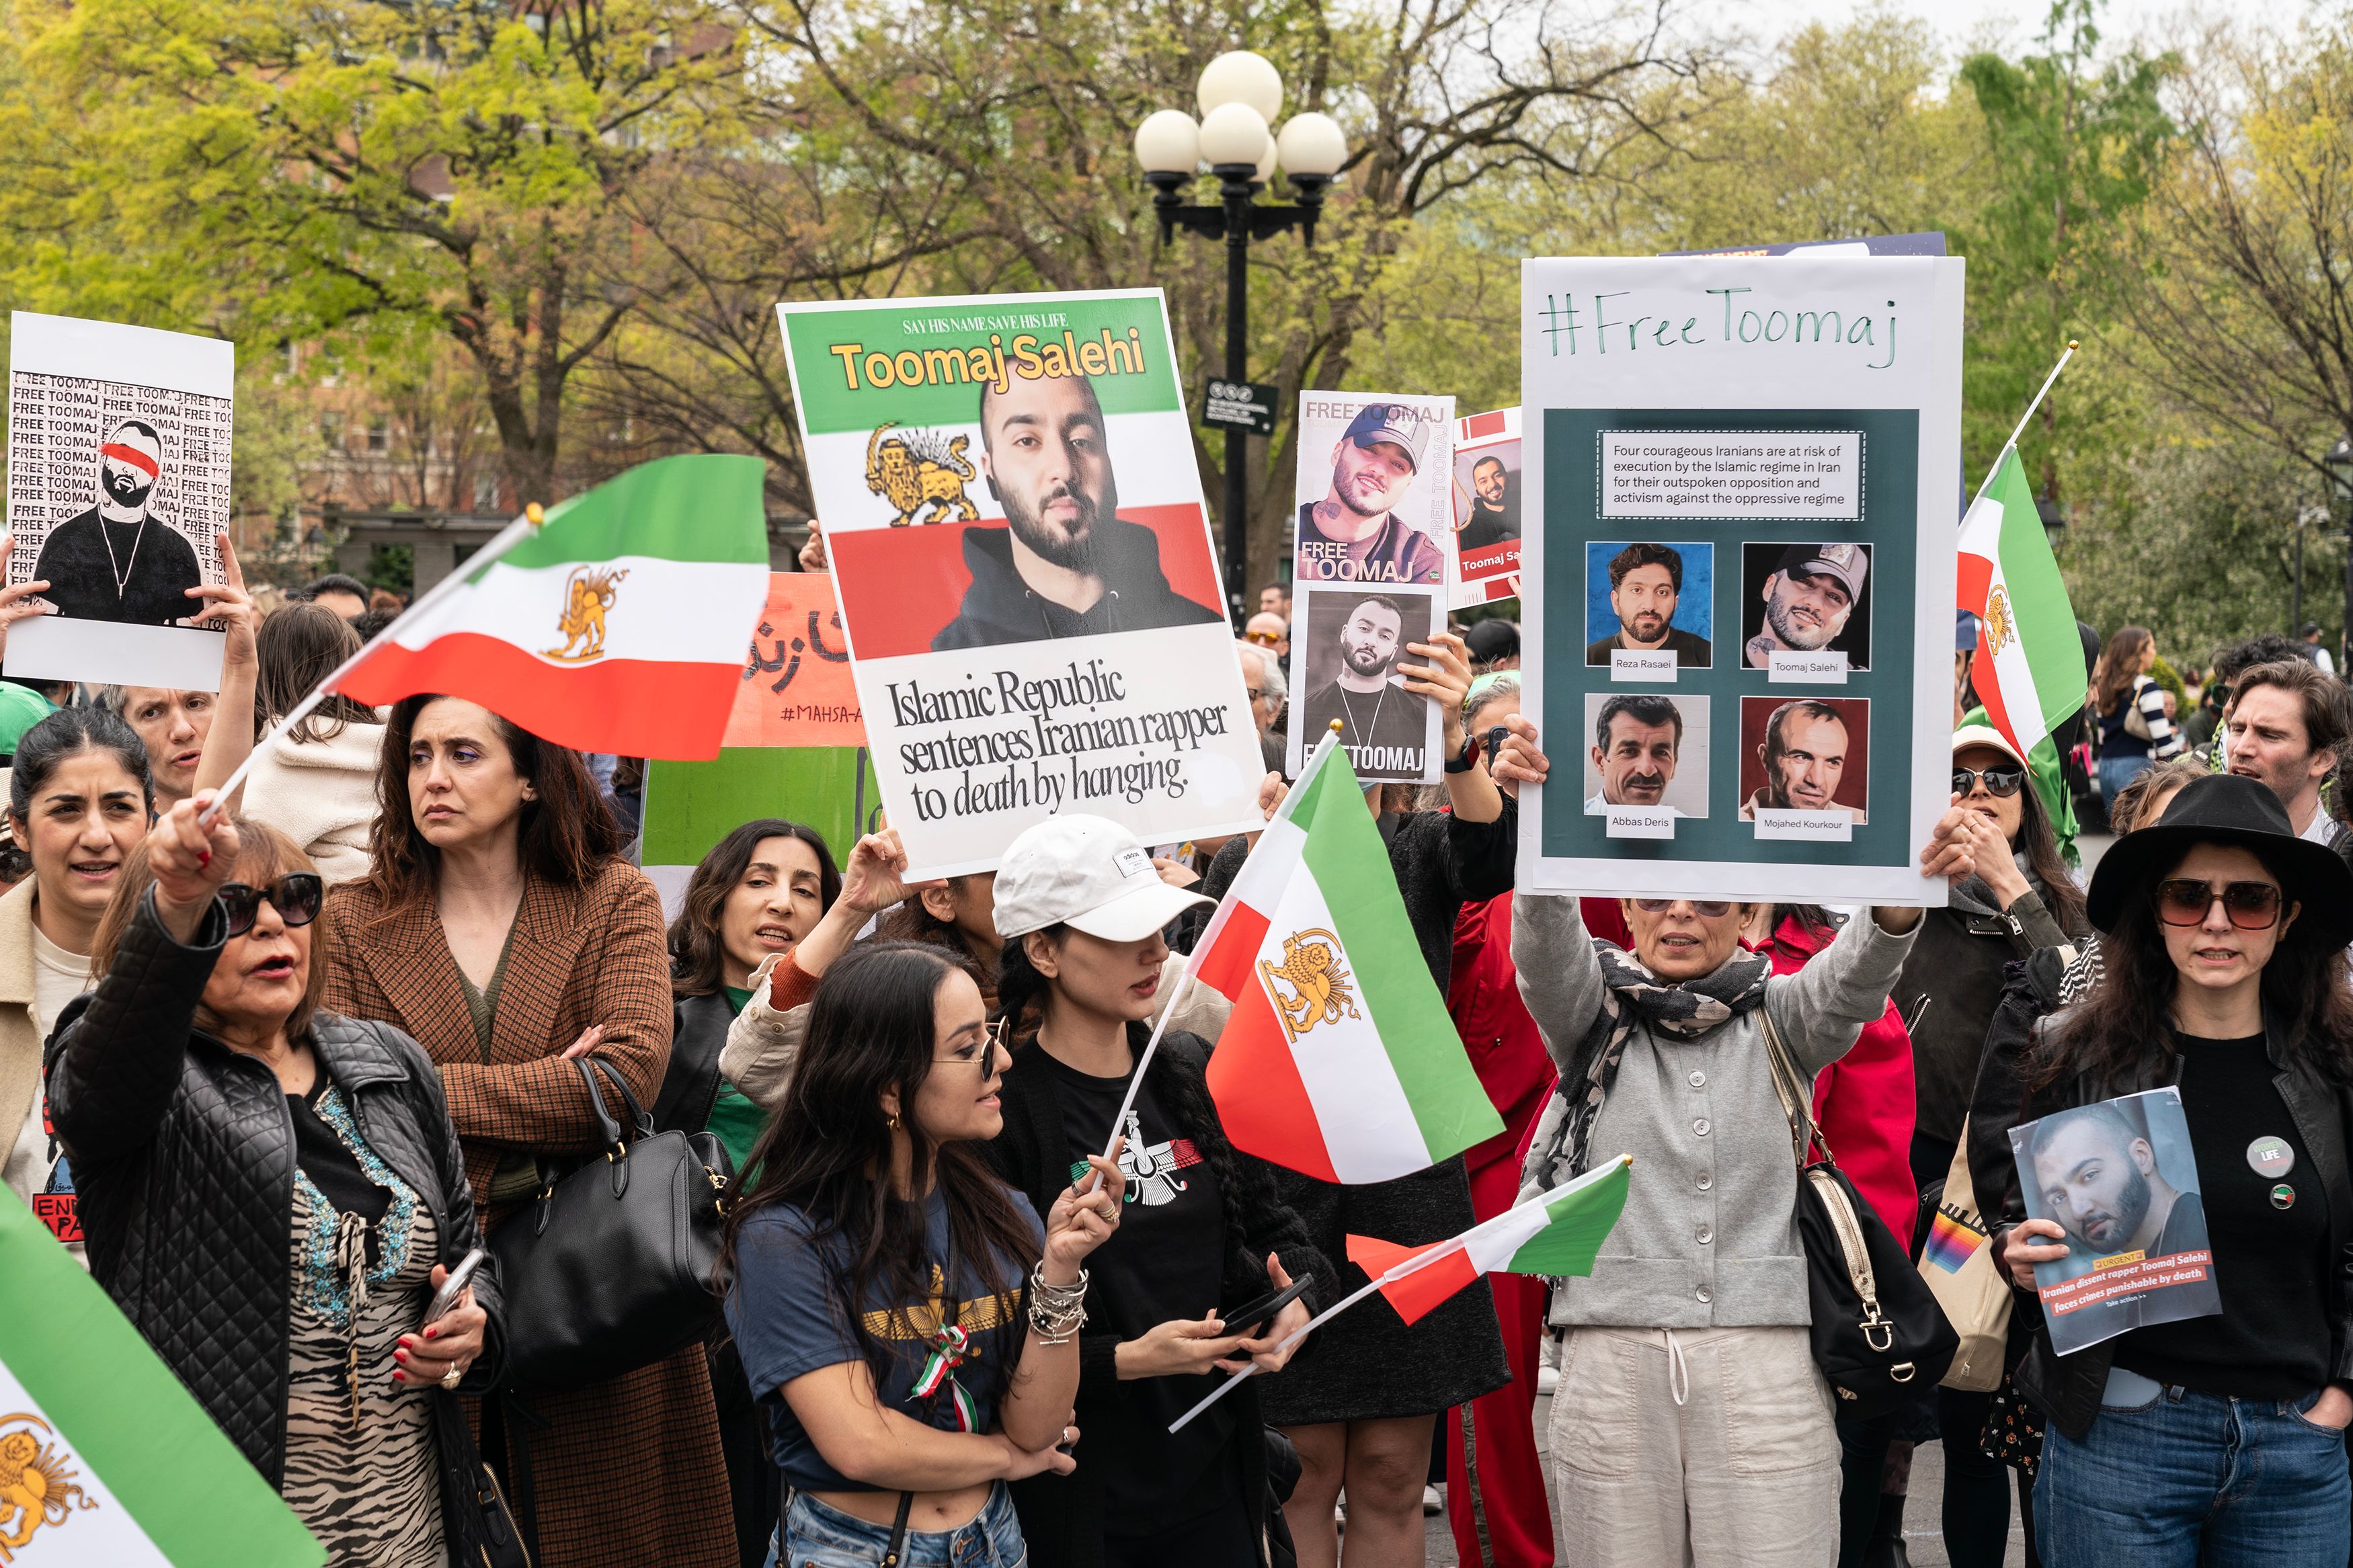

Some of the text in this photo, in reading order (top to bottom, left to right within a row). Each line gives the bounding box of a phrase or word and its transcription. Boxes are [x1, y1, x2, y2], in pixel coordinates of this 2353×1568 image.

[903, 313, 1068, 335] SAY HIS NAME SAVE HIS LIFE
[1538, 287, 1896, 369] #FreeToomaj
[829, 327, 1146, 395] Toomaj Salehi
[14, 387, 98, 405] FREE TOOMAJ
[184, 394, 210, 407] FREE
[13, 402, 97, 419] FREE TOOMAJ
[104, 398, 180, 417] FREE TOOMAJ
[185, 407, 210, 421] FREE
[1306, 401, 1444, 423] FREE TOOMAJ
[13, 417, 97, 434] FREE TOOMAJ
[184, 424, 210, 437] FREE
[13, 432, 97, 448] FREE TOOMAJ
[12, 446, 97, 463] FREE TOOMAJ
[1614, 446, 1841, 458] Four courageous Iranians are at risk of
[12, 460, 96, 477] FREE TOOMAJ
[182, 464, 208, 477] FREE
[1613, 461, 1840, 474] execution by the Islamic regime in Iran
[12, 474, 95, 491] FREE TOOMAJ
[182, 479, 208, 492] FREE
[1431, 425, 1447, 539] FREE TOOMAJ
[1613, 476, 1820, 490] for their outspoken opposition and
[12, 488, 95, 503] FREE TOOMAJ
[182, 493, 208, 505] FREE
[1613, 492, 1844, 506] activism against the oppressive regime
[13, 505, 46, 517] FREE
[183, 507, 209, 520] FREE
[12, 519, 44, 530] FREE
[184, 520, 210, 533] FREE
[1302, 541, 1347, 559] FREE
[1462, 552, 1504, 571] Toomaj
[1302, 558, 1413, 583] TOOMAJ
[1616, 659, 1671, 669] Reza Rasaei
[1775, 663, 1838, 673] Toomaj Salehi
[885, 659, 1125, 728] Islamic Republic
[900, 703, 1229, 774] sentences Iranian rapper
[911, 782, 947, 821] to
[954, 762, 1031, 817] death
[1031, 760, 1066, 815] by
[1069, 751, 1189, 804] hanging.
[1612, 817, 1669, 827] Abbas Deris
[1764, 819, 1843, 830] Mojahed Kourkour
[2260, 1149, 2280, 1161] LIFE
[2102, 1255, 2135, 1267] URGENT
[2042, 1252, 2208, 1298] Iranian dissent rapper Toomaj Salehi
[2054, 1268, 2202, 1313] faces crimes punishable by death
[2106, 1300, 2119, 1308] Take
[2119, 1295, 2138, 1305] action
